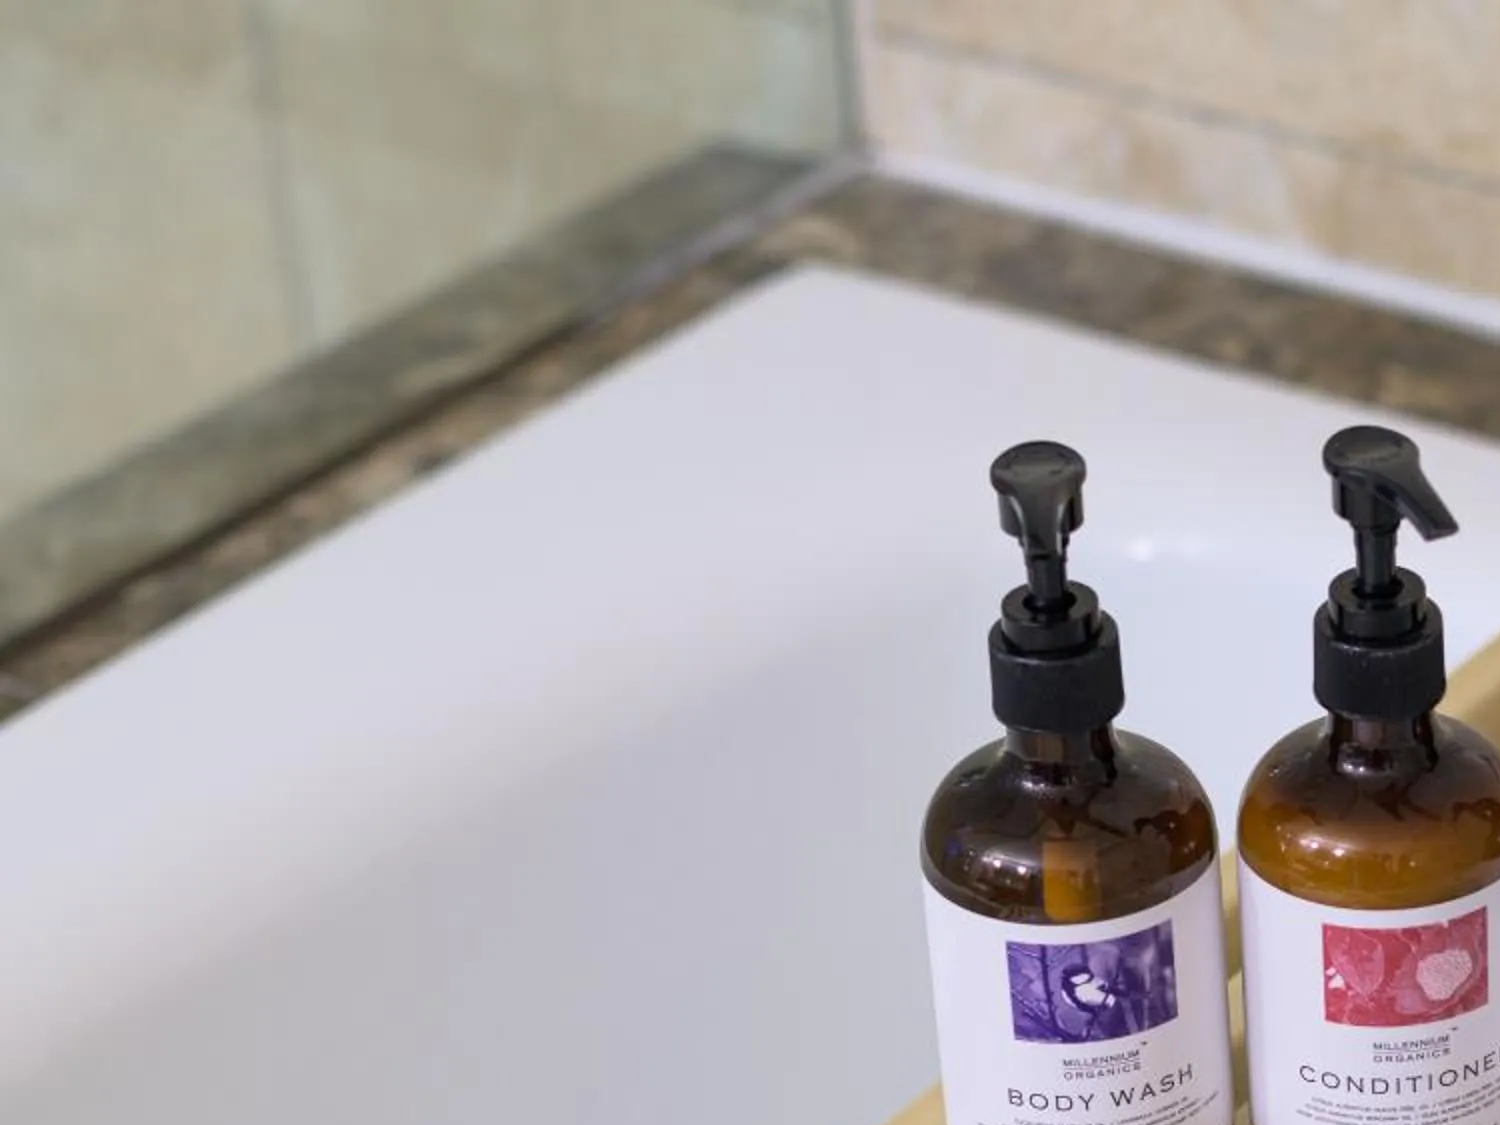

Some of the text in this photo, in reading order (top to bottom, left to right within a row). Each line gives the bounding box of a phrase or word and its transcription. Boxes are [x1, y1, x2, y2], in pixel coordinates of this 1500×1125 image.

[1373, 1033, 1450, 1050] MILLENNIUM
[1063, 1049, 1140, 1067] MILLENNIUM
[1373, 1048, 1450, 1063] ORGANICS
[1063, 1063, 1141, 1081] ORGANICS
[1007, 1063, 1194, 1112] BODY WASH
